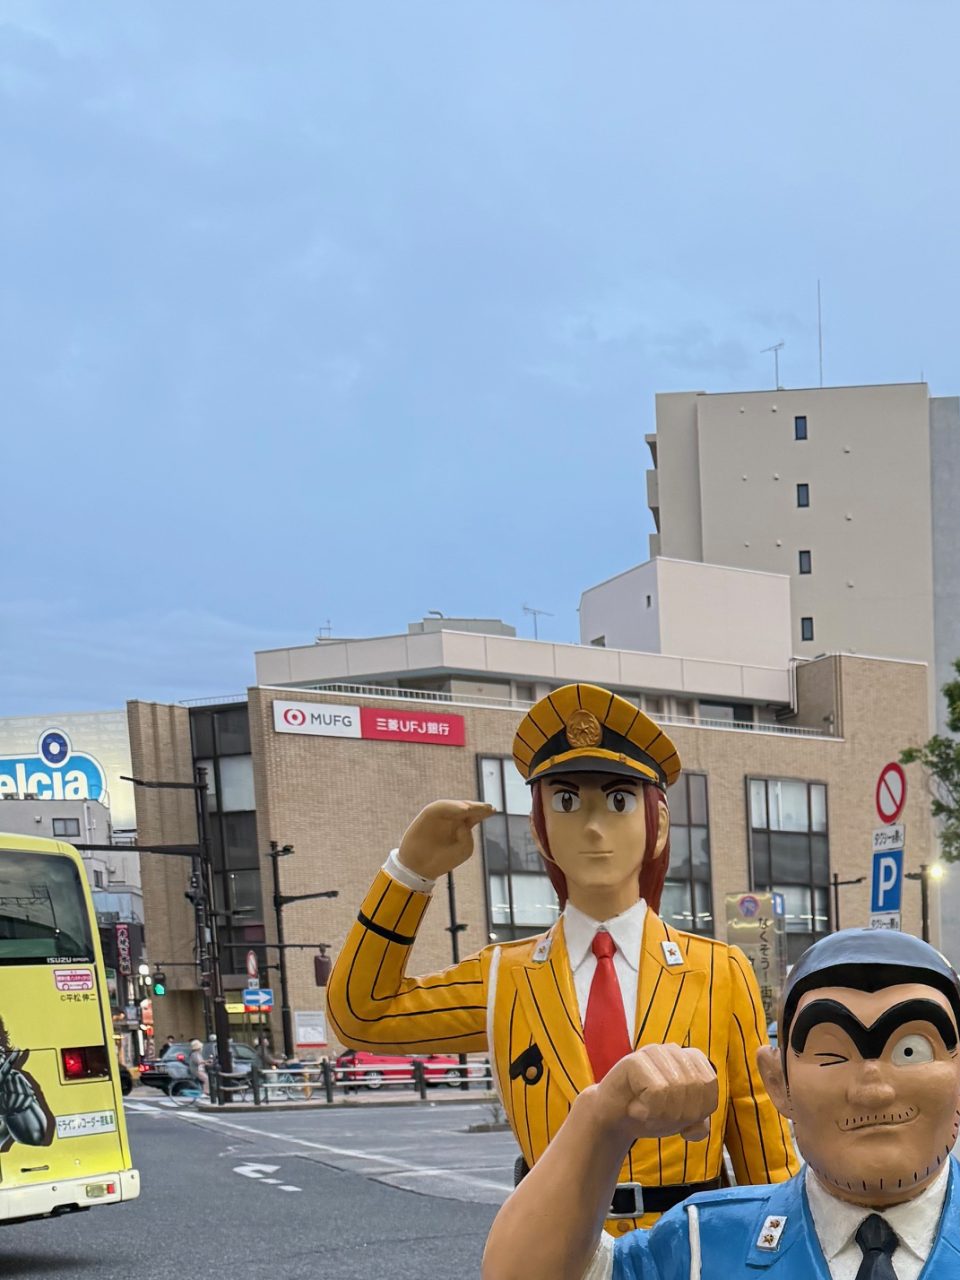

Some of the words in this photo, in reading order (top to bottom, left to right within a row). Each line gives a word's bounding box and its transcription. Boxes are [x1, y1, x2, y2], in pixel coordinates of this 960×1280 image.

[310, 713, 352, 727] MUFG
[376, 718, 449, 736] 三菱UFJ銀行
[878, 857, 898, 907] P
